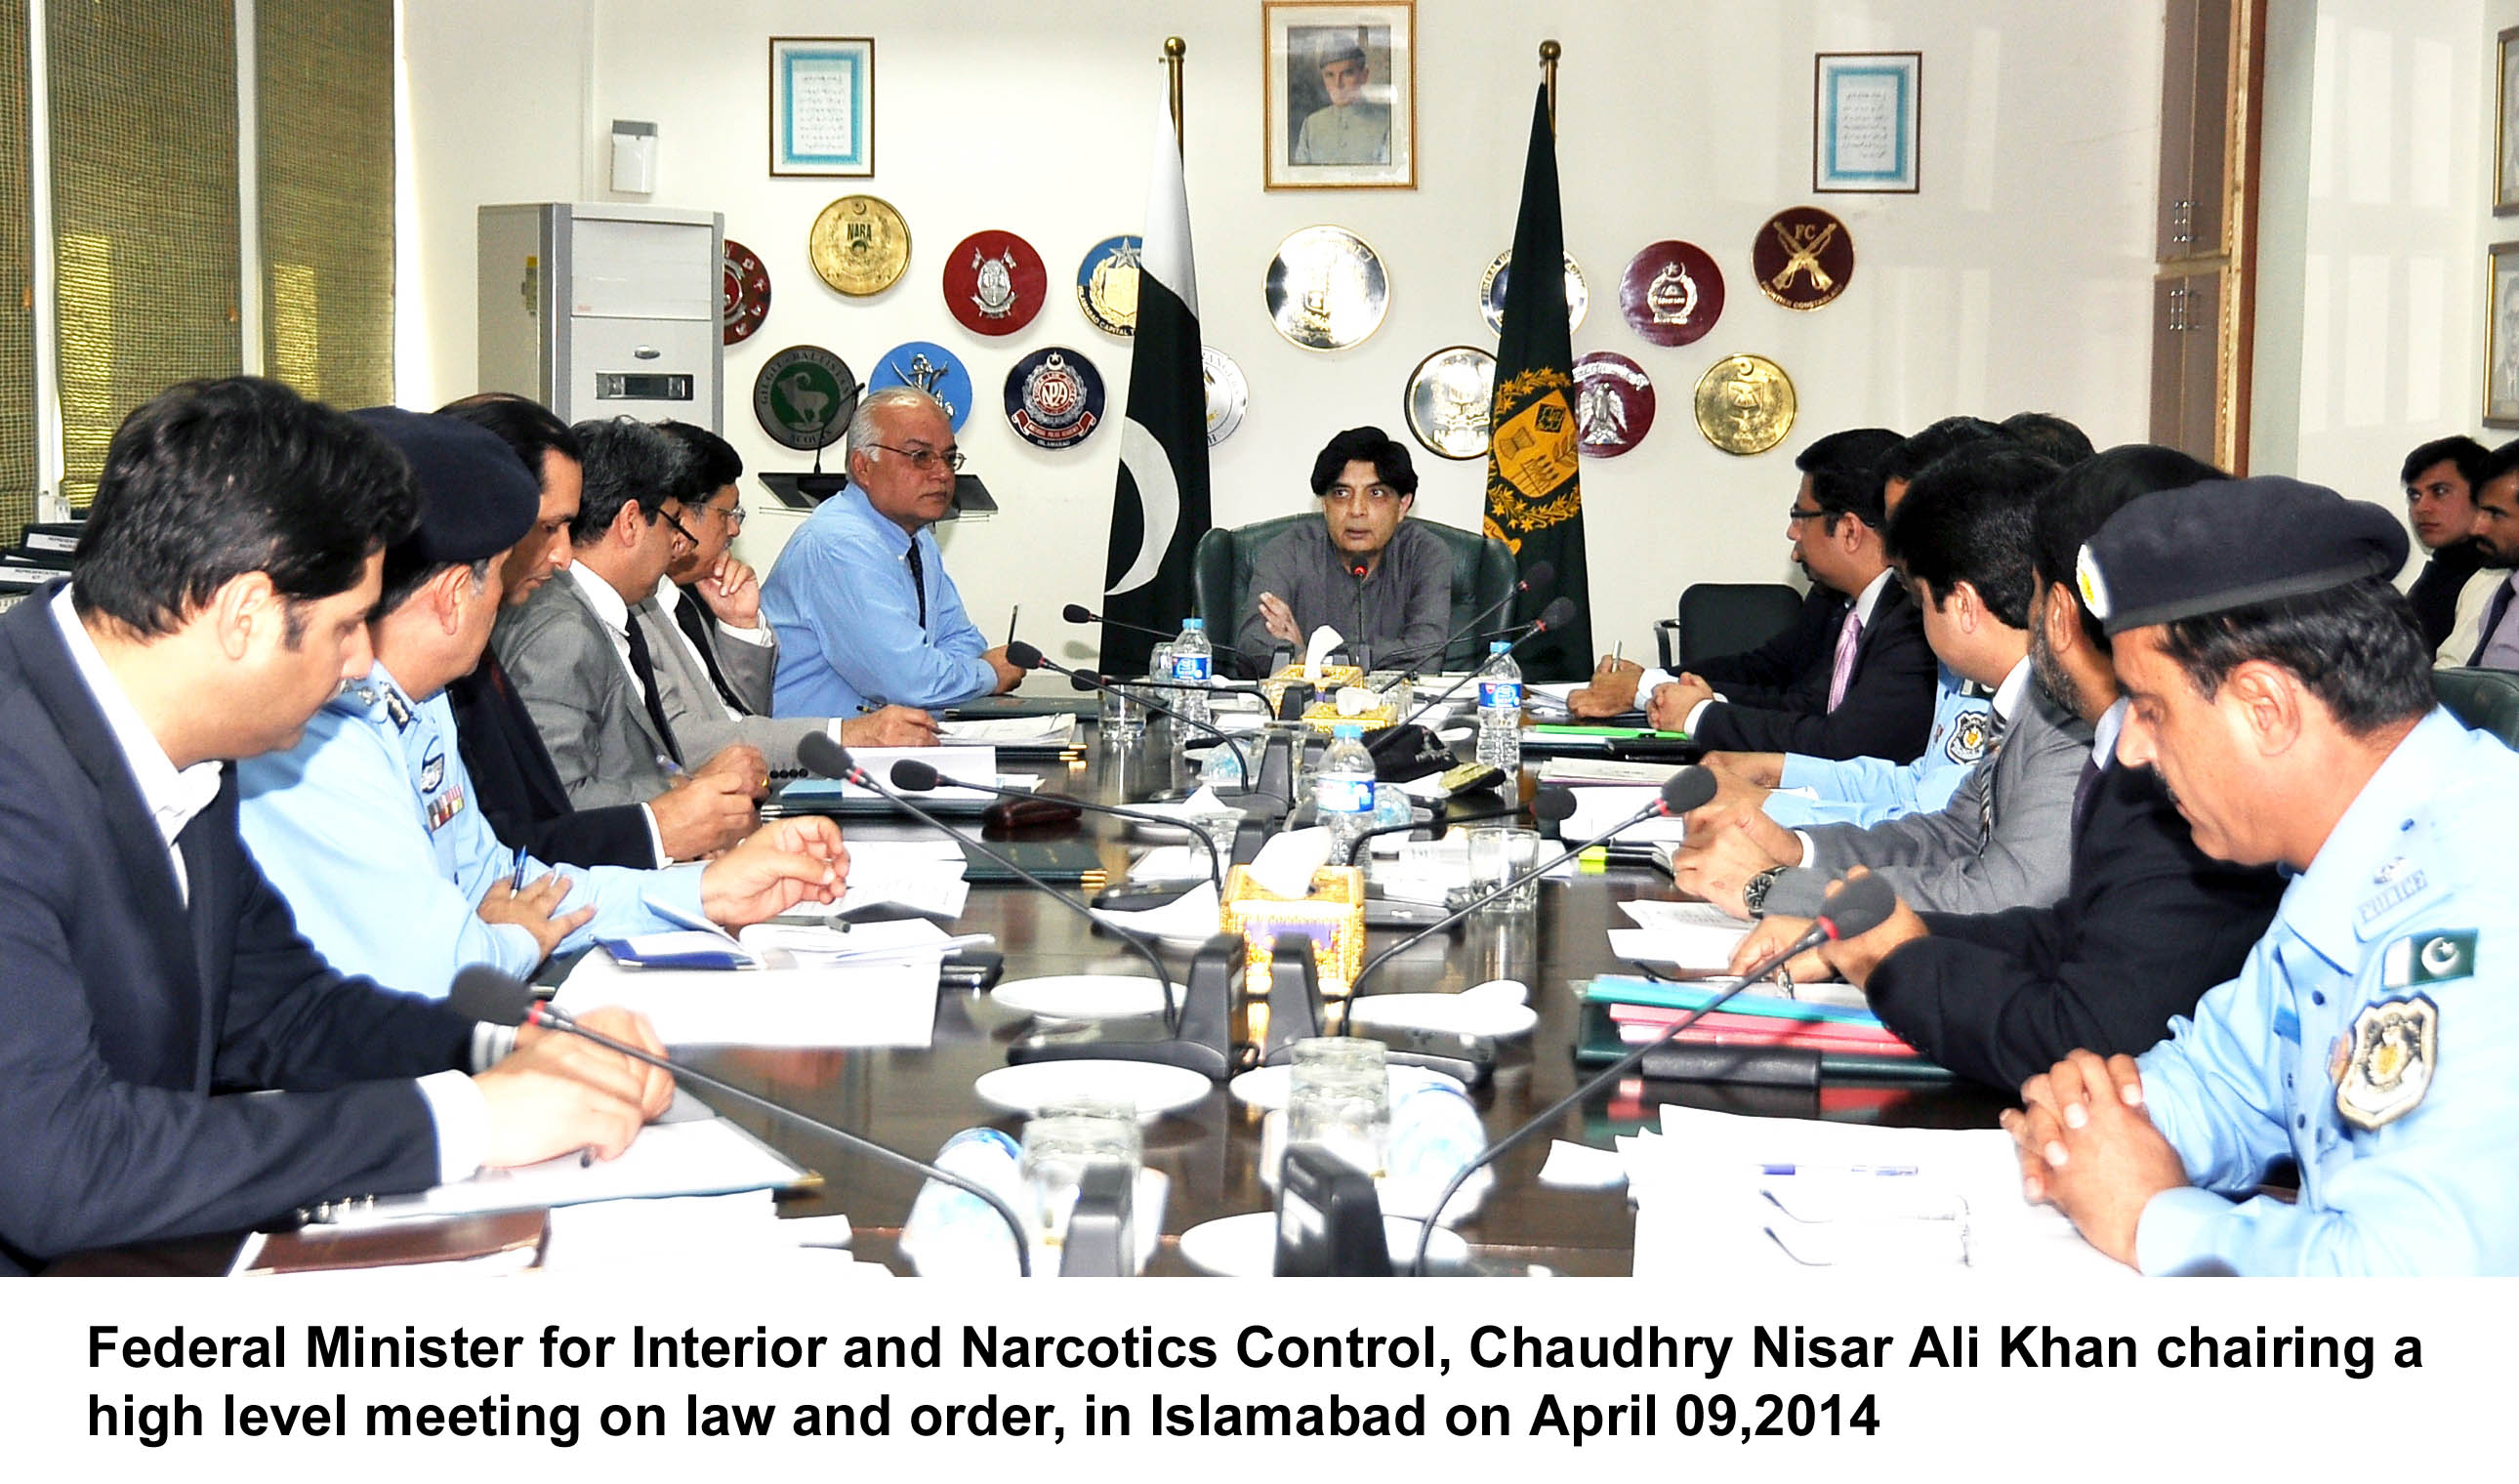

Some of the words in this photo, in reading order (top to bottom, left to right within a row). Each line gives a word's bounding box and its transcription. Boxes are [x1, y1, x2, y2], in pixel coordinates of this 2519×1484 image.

[847, 223, 872, 241] NARA
[1795, 224, 1816, 239] FC
[1098, 321, 1130, 336] CAPITAL
[2357, 868, 2428, 924] POLICE
